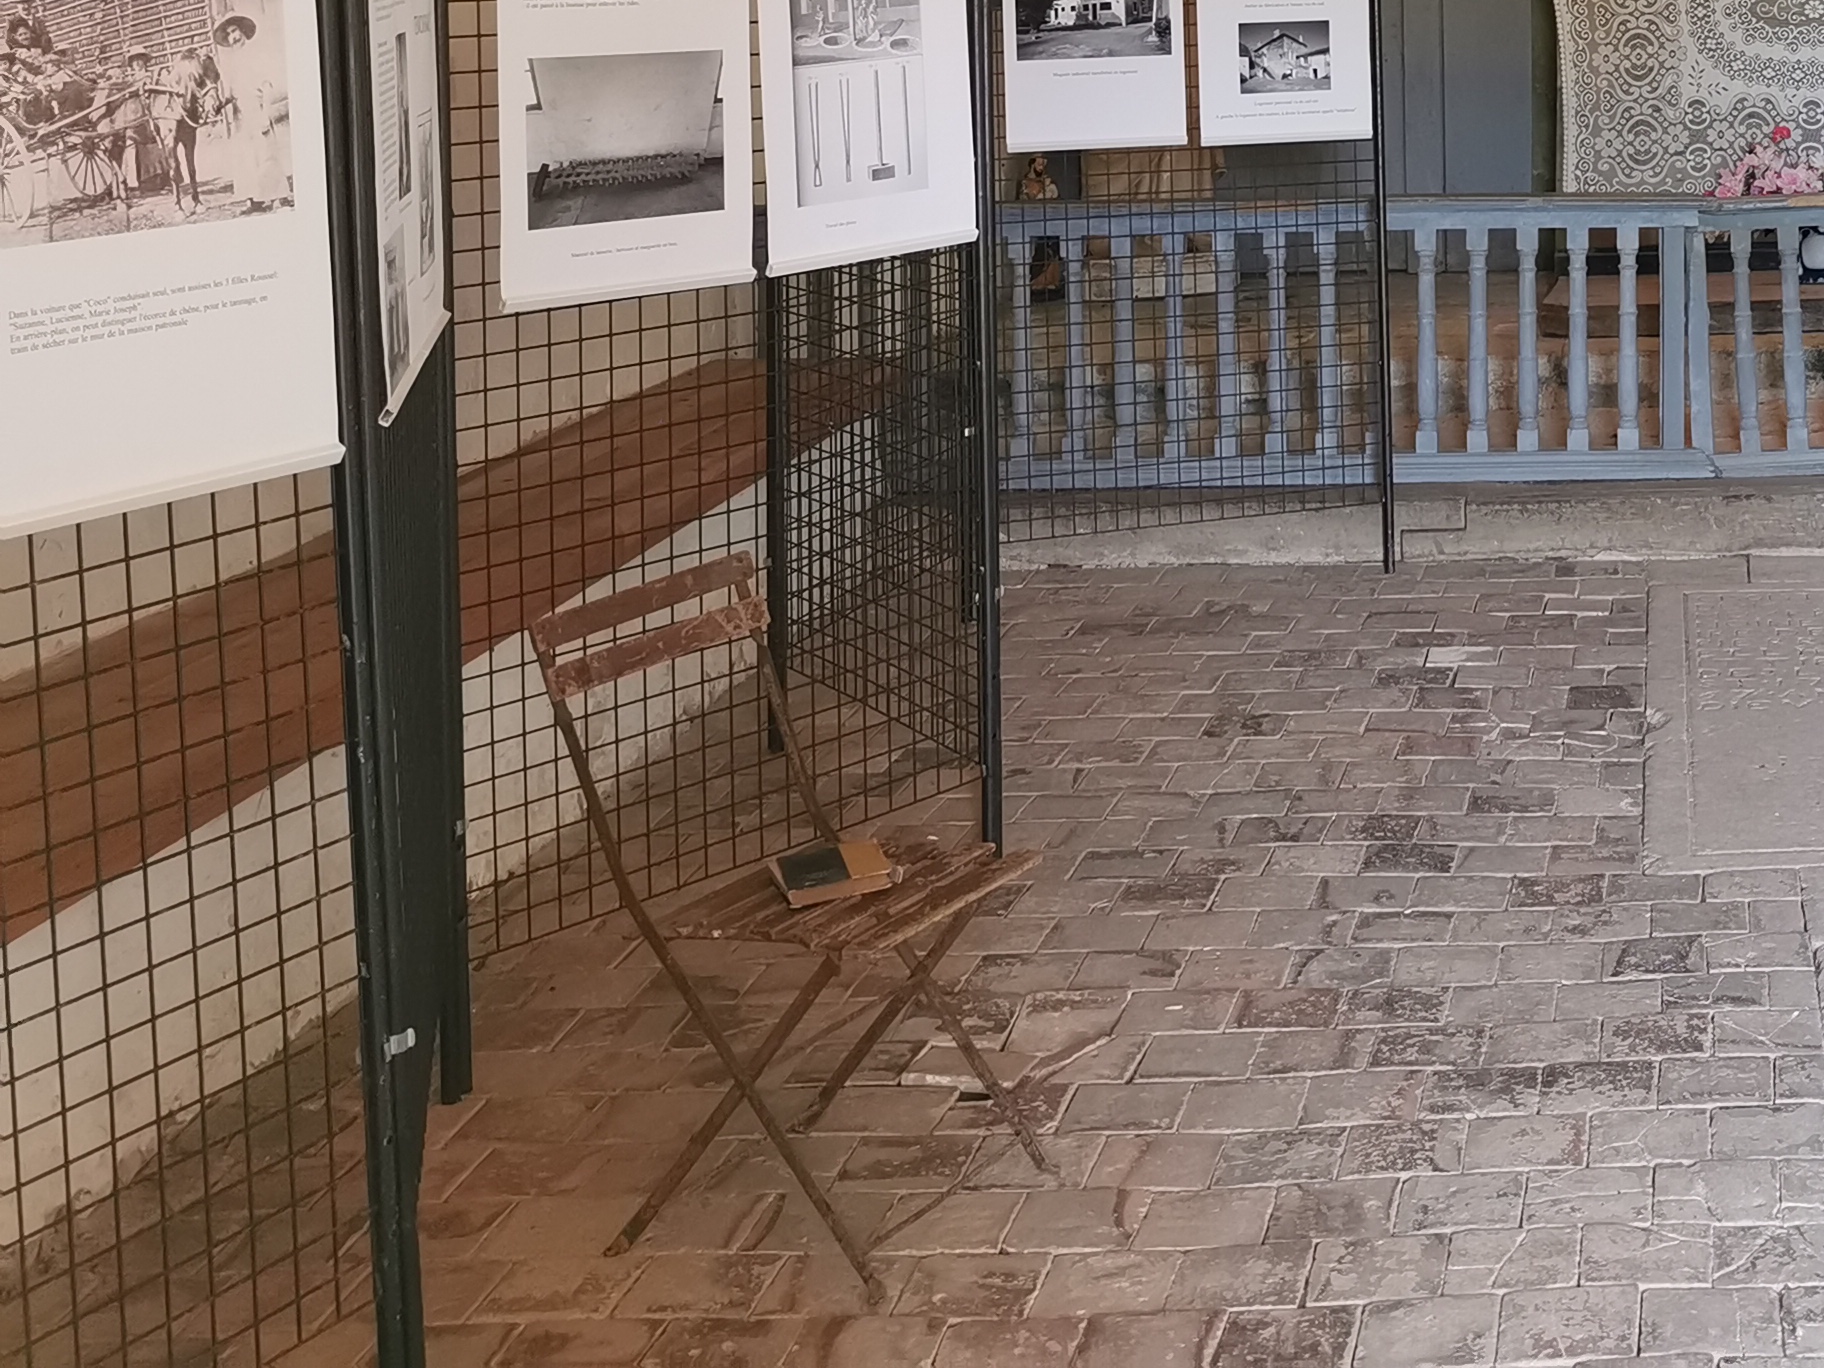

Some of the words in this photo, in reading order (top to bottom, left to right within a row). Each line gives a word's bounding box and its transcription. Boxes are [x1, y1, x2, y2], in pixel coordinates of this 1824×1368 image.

[9, 311, 28, 320] Dans
[30, 308, 38, 316] la
[40, 305, 66, 315] voiture
[68, 303, 82, 313] que
[84, 296, 111, 308] "Coco"
[170, 284, 186, 295] sont
[213, 280, 223, 288] les
[225, 278, 229, 286] 3
[231, 276, 248, 285] filles
[89, 308, 111, 319] Marie
[10, 335, 21, 343] En
[83, 321, 99, 334] peut
[101, 317, 137, 328] distinguer
[169, 309, 178, 317] de
[203, 303, 220, 314] pour
[221, 300, 228, 309] le
[30, 343, 39, 351] de
[42, 338, 66, 349] sécher
[68, 336, 79, 344] sur
[81, 333, 88, 342] le
[107, 329, 116, 337] de
[118, 327, 125, 335] la
